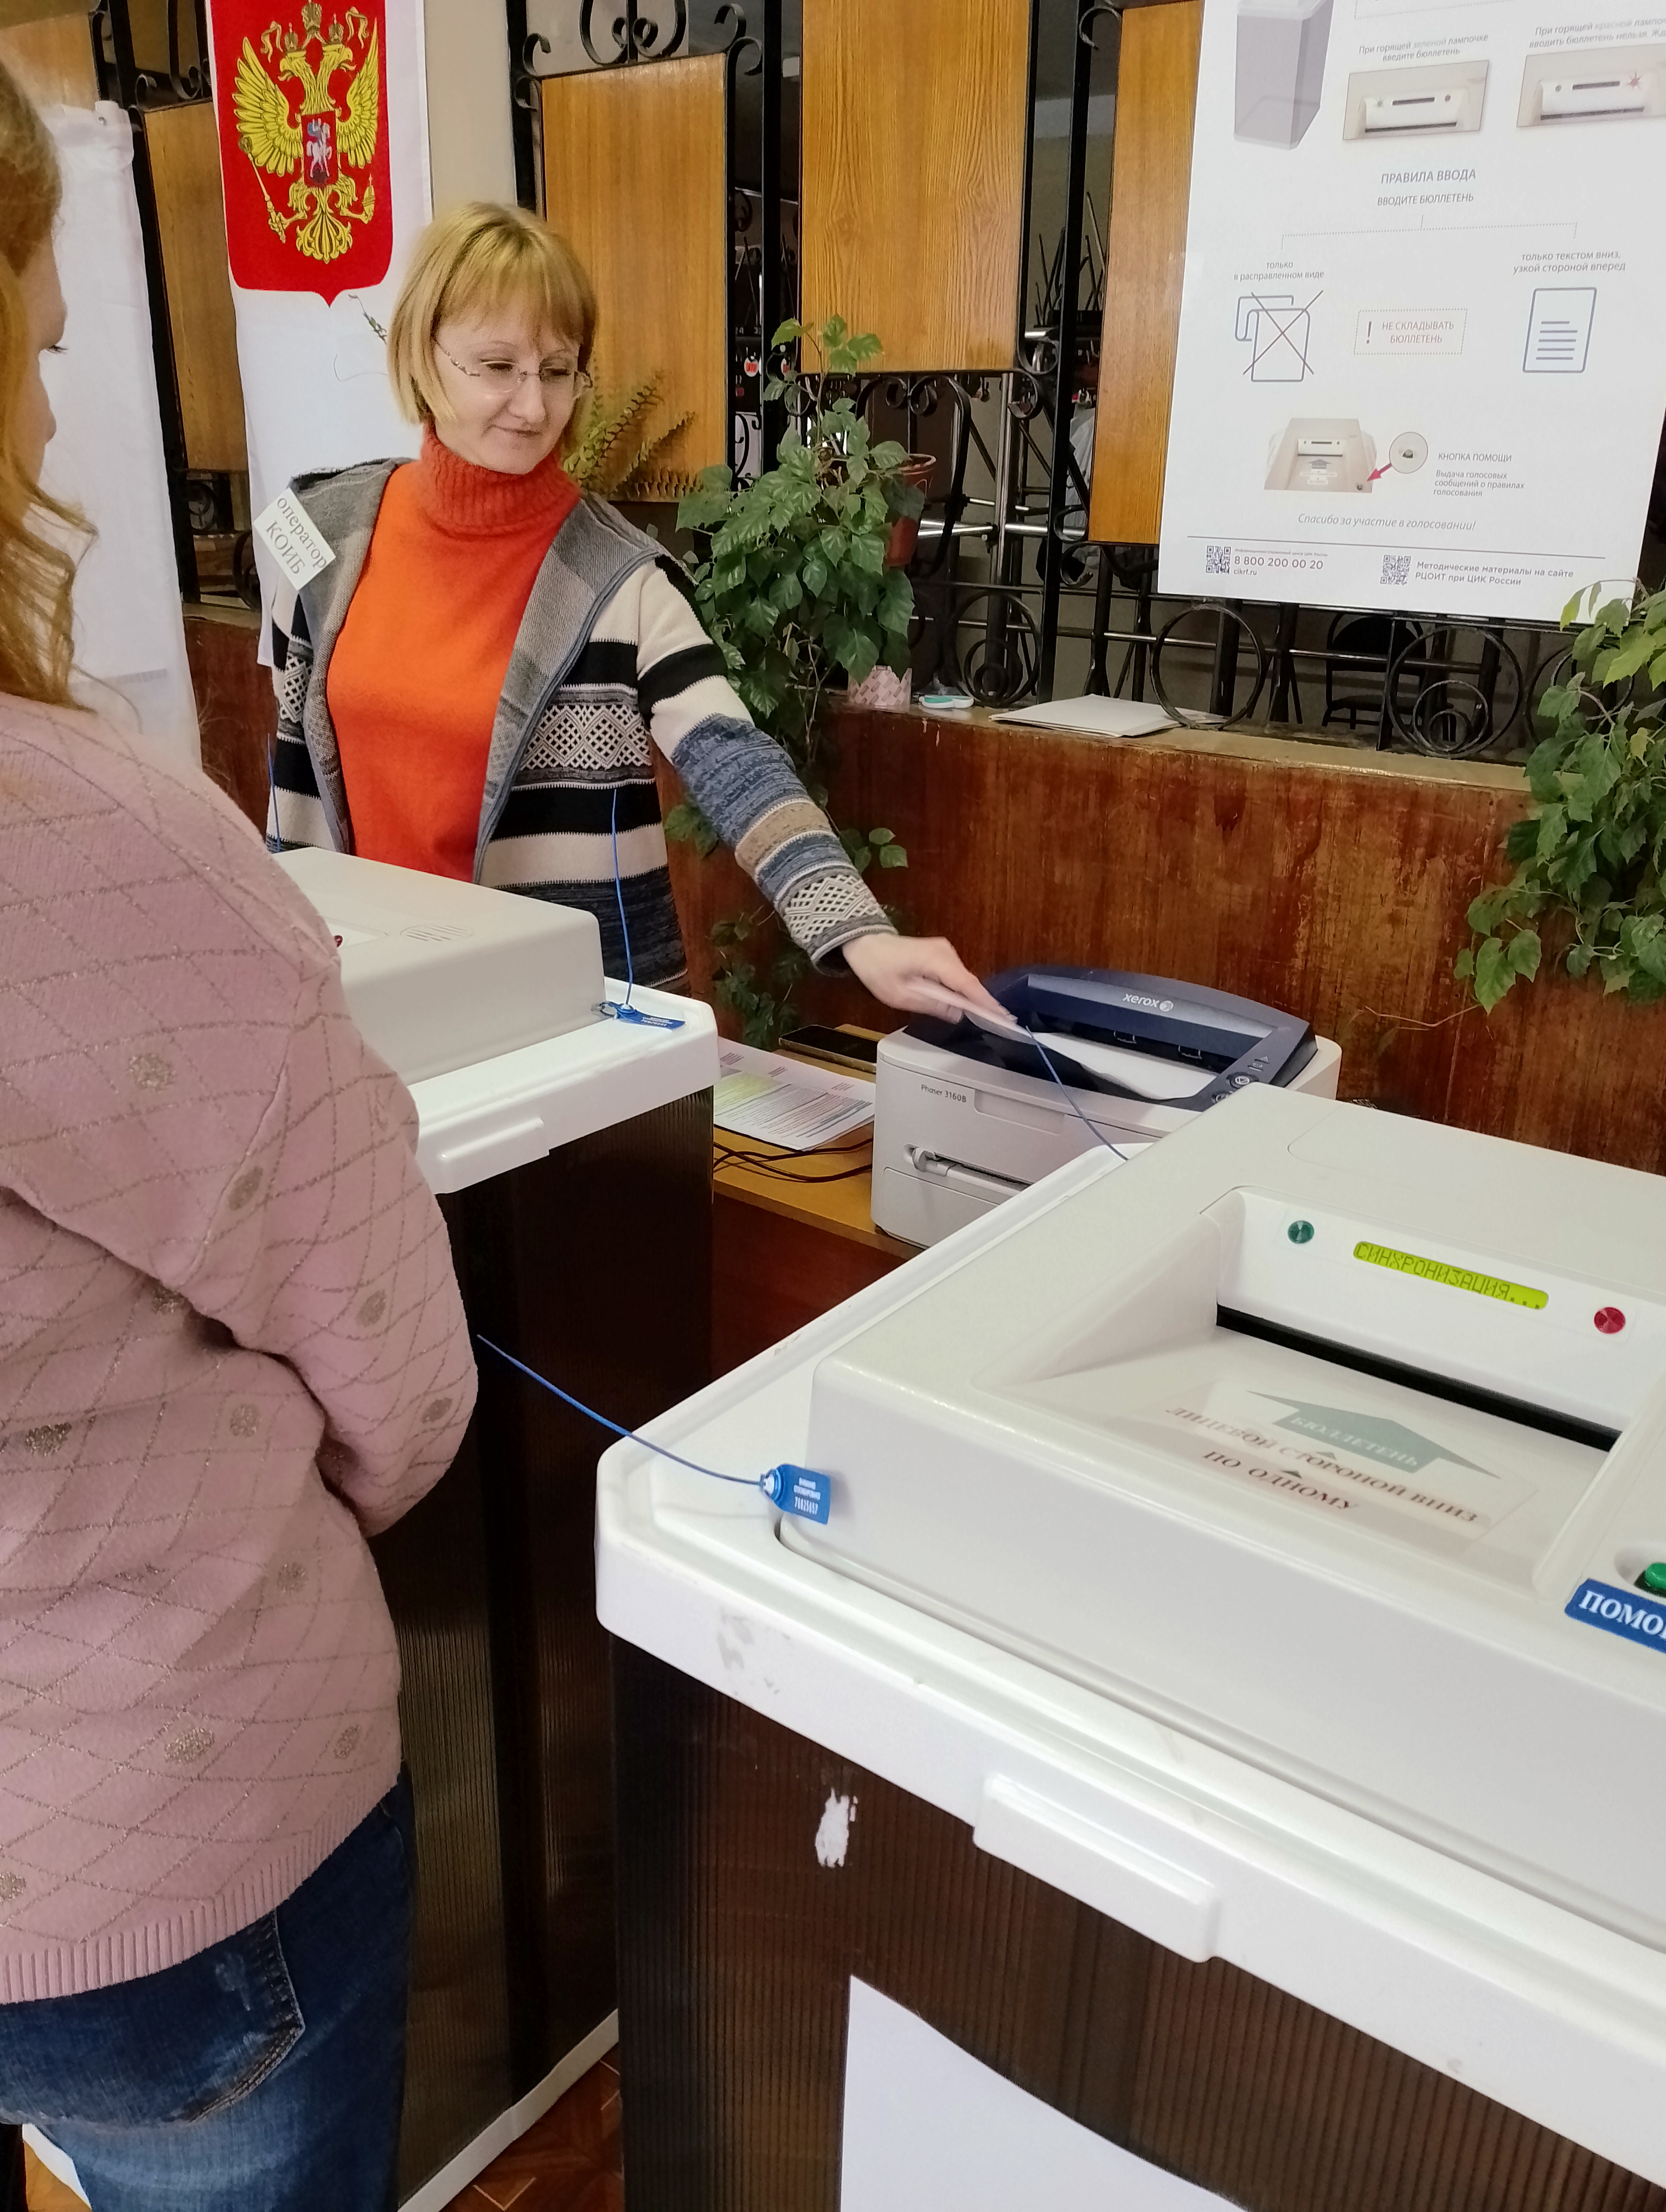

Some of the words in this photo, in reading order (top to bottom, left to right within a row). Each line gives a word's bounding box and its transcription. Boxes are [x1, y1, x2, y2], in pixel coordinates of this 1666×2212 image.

[1535, 26, 1553, 37] При
[1555, 22, 1593, 35] горящей
[1359, 46, 1375, 55] При
[1376, 41, 1412, 53] горящей
[1447, 34, 1489, 46] лампочке
[1529, 38, 1564, 49] вводить
[1566, 33, 1614, 45] бюллетень
[1383, 52, 1414, 62] введите
[1416, 48, 1460, 59] бюллетень
[1381, 171, 1434, 184] ПРАВИЛА
[1437, 169, 1476, 182] ВВОДА
[1377, 195, 1418, 207] ВВОДИТЕ
[1419, 192, 1474, 204] БЮЛЛЕТЕНЬ
[1521, 253, 1554, 261] только
[1556, 252, 1594, 261] текстом
[1595, 250, 1621, 260] вниз,
[1266, 261, 1294, 269] только
[1513, 263, 1540, 275] узкой
[1542, 263, 1588, 274] стороной
[1590, 262, 1626, 273] вперед
[1240, 271, 1303, 282] расправленном
[1304, 271, 1324, 280] виде
[1382, 322, 1393, 331] НЕ
[1395, 321, 1454, 332] СКЛАДЫВАТЬ
[1390, 335, 1443, 344] БЮЛЛЕТЕНЬ
[1438, 452, 1471, 461] КНОПКА
[1472, 453, 1512, 462] ПОМОЩИ
[1436, 469, 1464, 479] Выдача
[1434, 479, 1479, 488] сообщений
[1487, 482, 1525, 490] правилах
[1433, 489, 1483, 497] голосования
[1298, 513, 1339, 525] Спасибо
[1340, 517, 1352, 526] за
[1352, 517, 1397, 528] участие
[1399, 518, 1405, 528] в
[1406, 519, 1477, 531] голосовании!
[277, 497, 327, 569] оператор
[266, 520, 305, 575] КОИБ
[1234, 556, 1240, 565] 8
[1244, 556, 1265, 566] 800
[1267, 557, 1289, 568] 200
[1292, 558, 1307, 569] 00
[1309, 560, 1323, 570] 20
[1417, 561, 1479, 573] Методические
[1482, 566, 1532, 576] материалы
[1547, 569, 1574, 578] сайте
[1233, 568, 1257, 576] cikrf.ru
[1415, 571, 1446, 581] РЦОИТ
[1448, 575, 1465, 584] при
[1467, 575, 1487, 584] ЦИК
[1489, 576, 1521, 586] России
[1122, 993, 1160, 1008] xerox
[921, 1084, 943, 1096] Phaser
[945, 1090, 967, 1103] 3160B
[1290, 1416, 1418, 1467] БЮЛЛЕТЕНЬ
[1165, 1407, 1278, 1449] ЛИЦЕВОЙ
[1279, 1447, 1406, 1496] СТОРОНОЙ
[1411, 1493, 1478, 1522] ВНИЗ
[1203, 1451, 1241, 1468] ПО
[1248, 1468, 1359, 1509] ОДНОМУ
[1579, 1590, 1666, 1641] ПОМО
